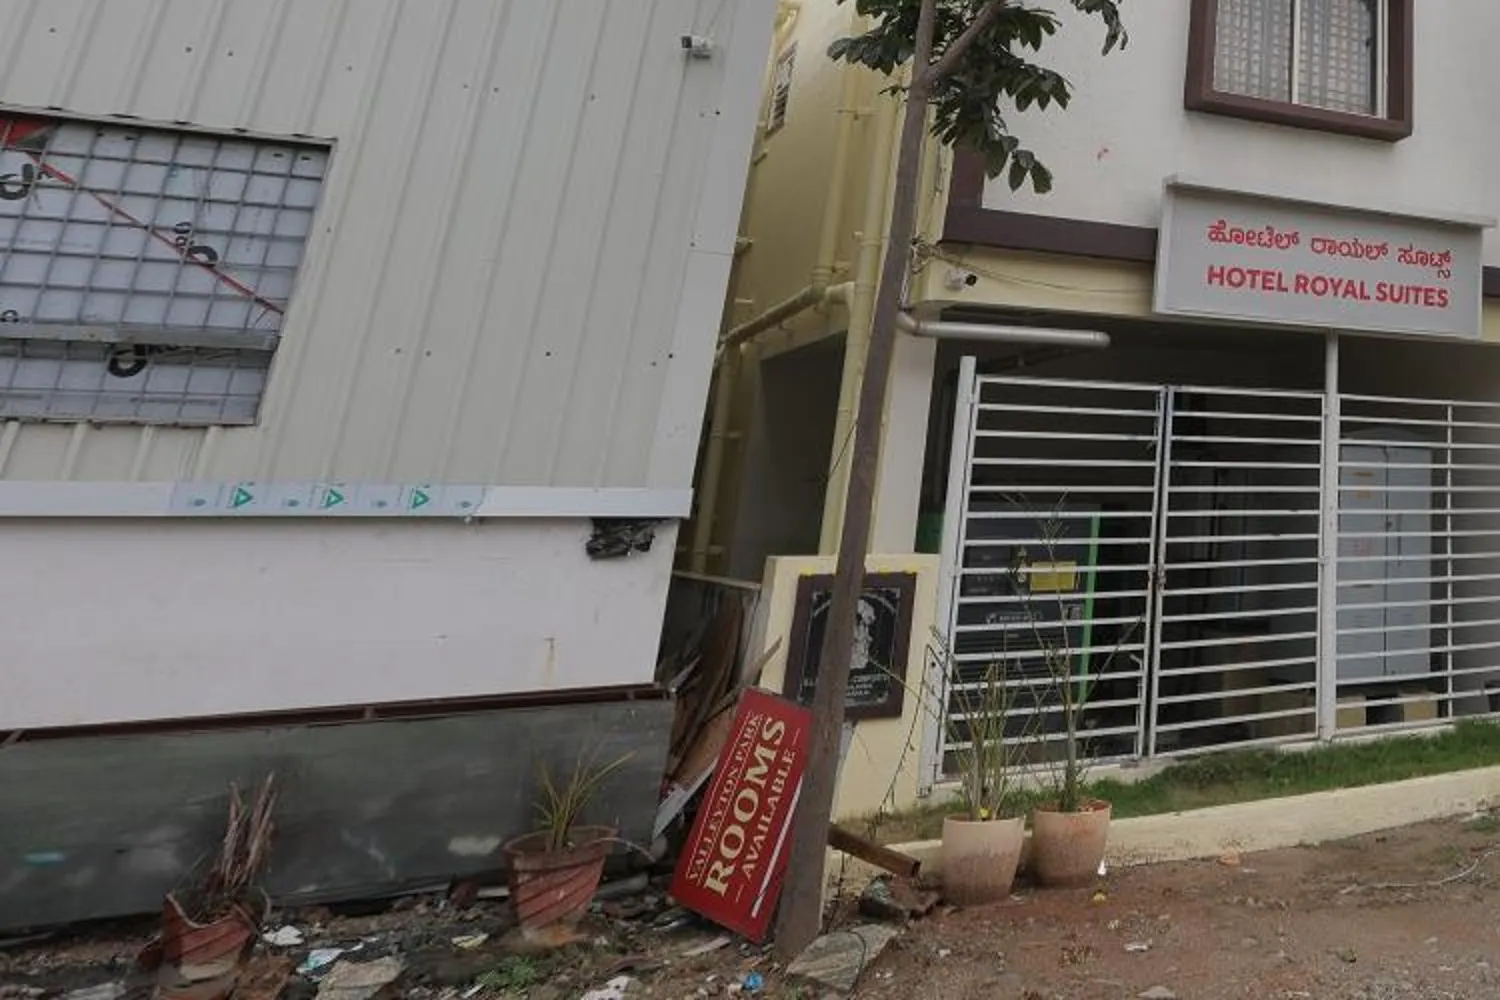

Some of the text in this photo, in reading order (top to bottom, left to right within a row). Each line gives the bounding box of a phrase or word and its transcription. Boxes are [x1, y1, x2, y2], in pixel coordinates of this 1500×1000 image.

[1208, 219, 1300, 249] ಹೋಟೆಲ್
[1207, 265, 1449, 308] HOTEL ROYAL SUITES
[704, 716, 786, 896] ROOMS
[742, 749, 796, 880] AVAILABLE
